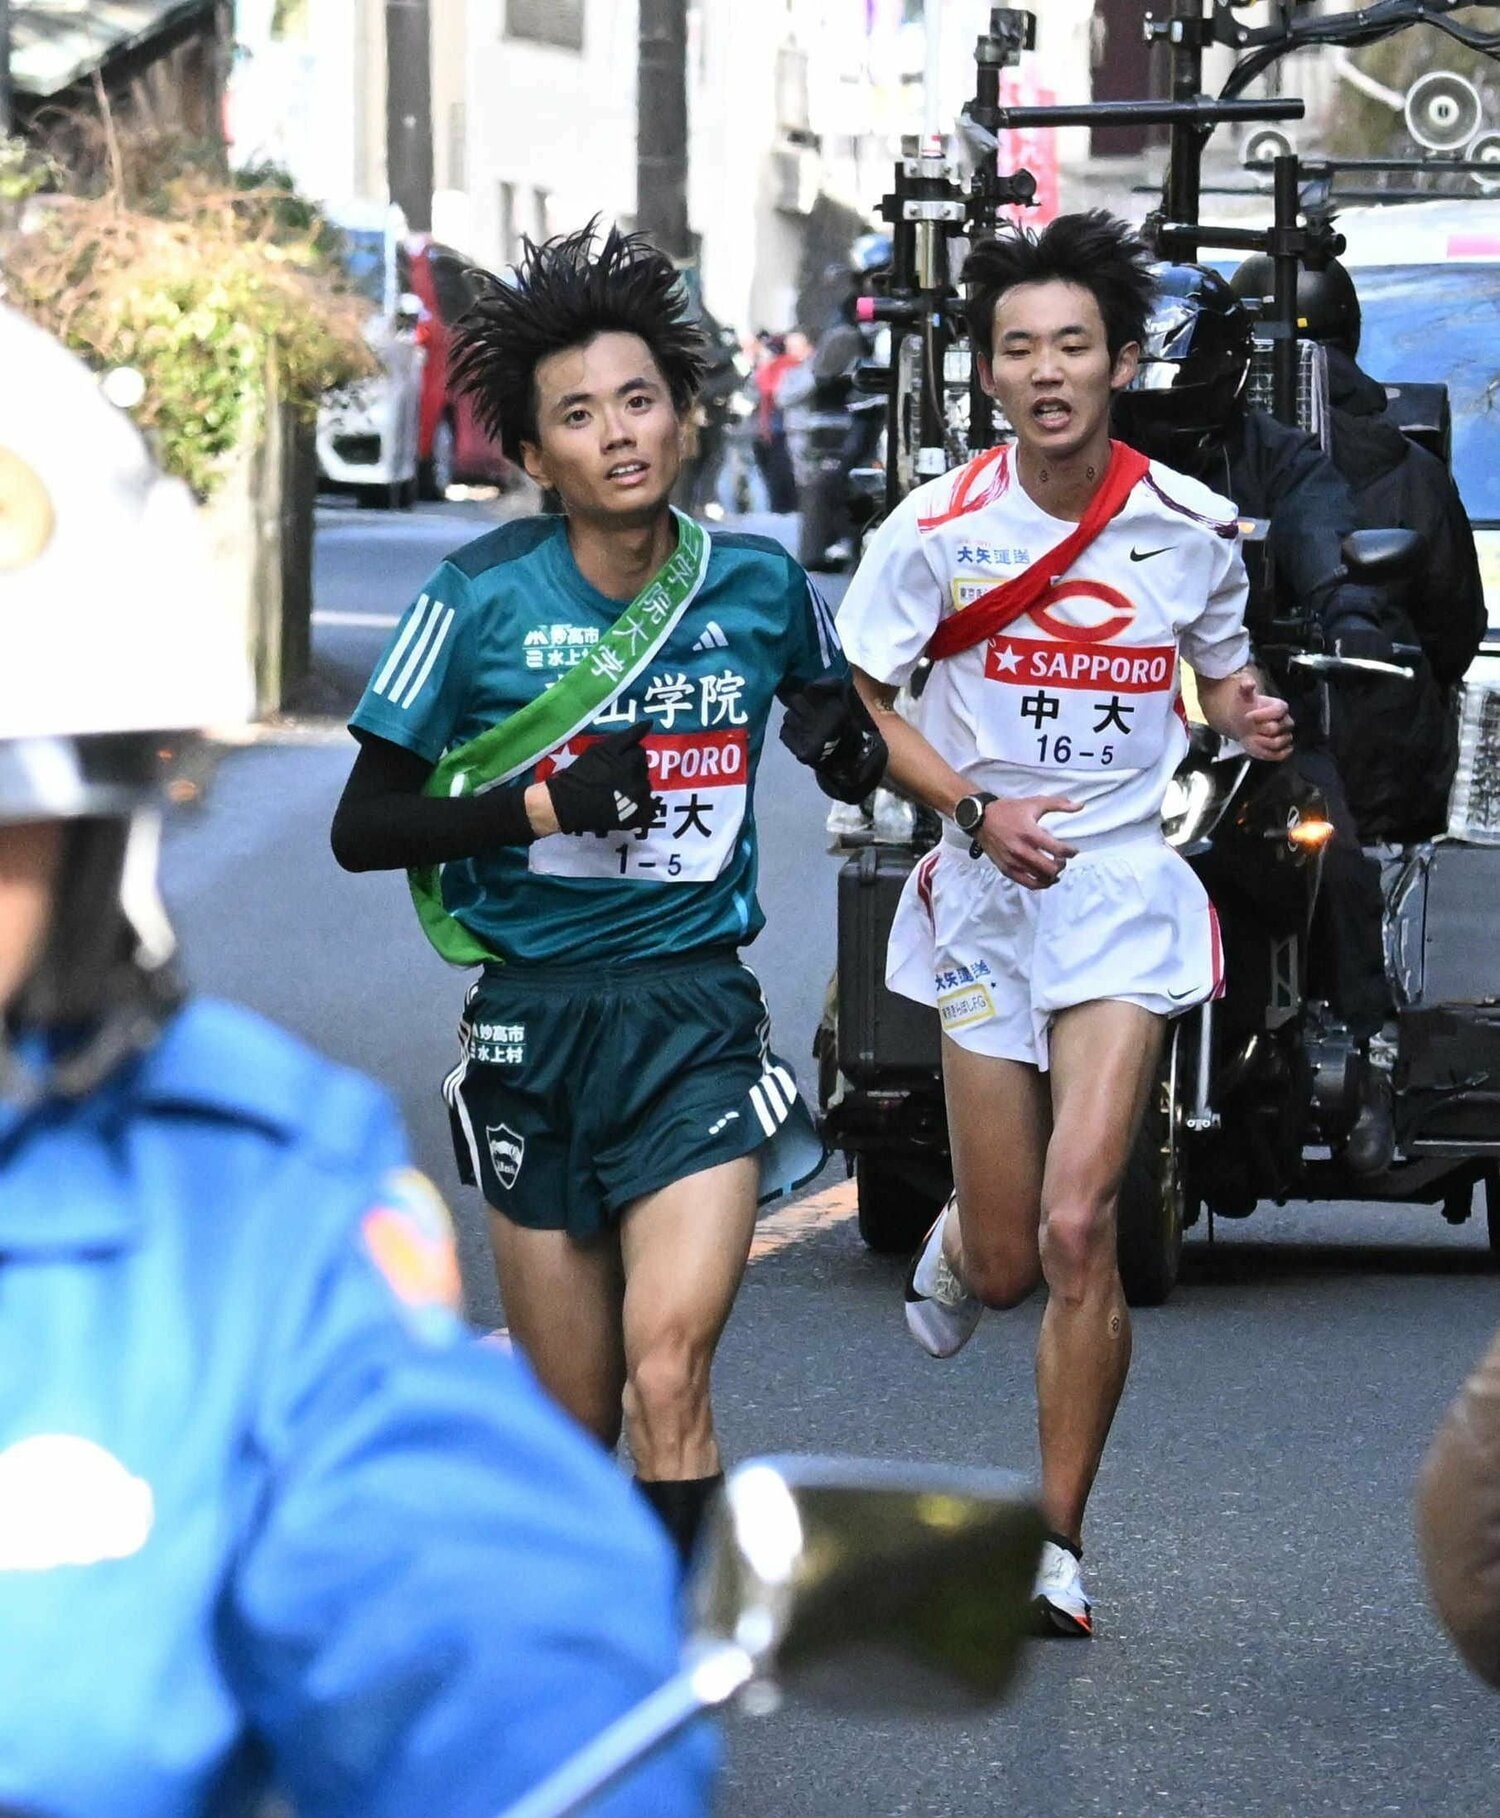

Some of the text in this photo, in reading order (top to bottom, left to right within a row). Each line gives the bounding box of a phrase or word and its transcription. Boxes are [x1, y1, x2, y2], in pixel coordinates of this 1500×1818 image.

[1030, 651, 1167, 684] SAPPORO
[545, 669, 749, 729] 山学院
[479, 1023, 525, 1043] 妙高市
[477, 1044, 523, 1063] 水上村
